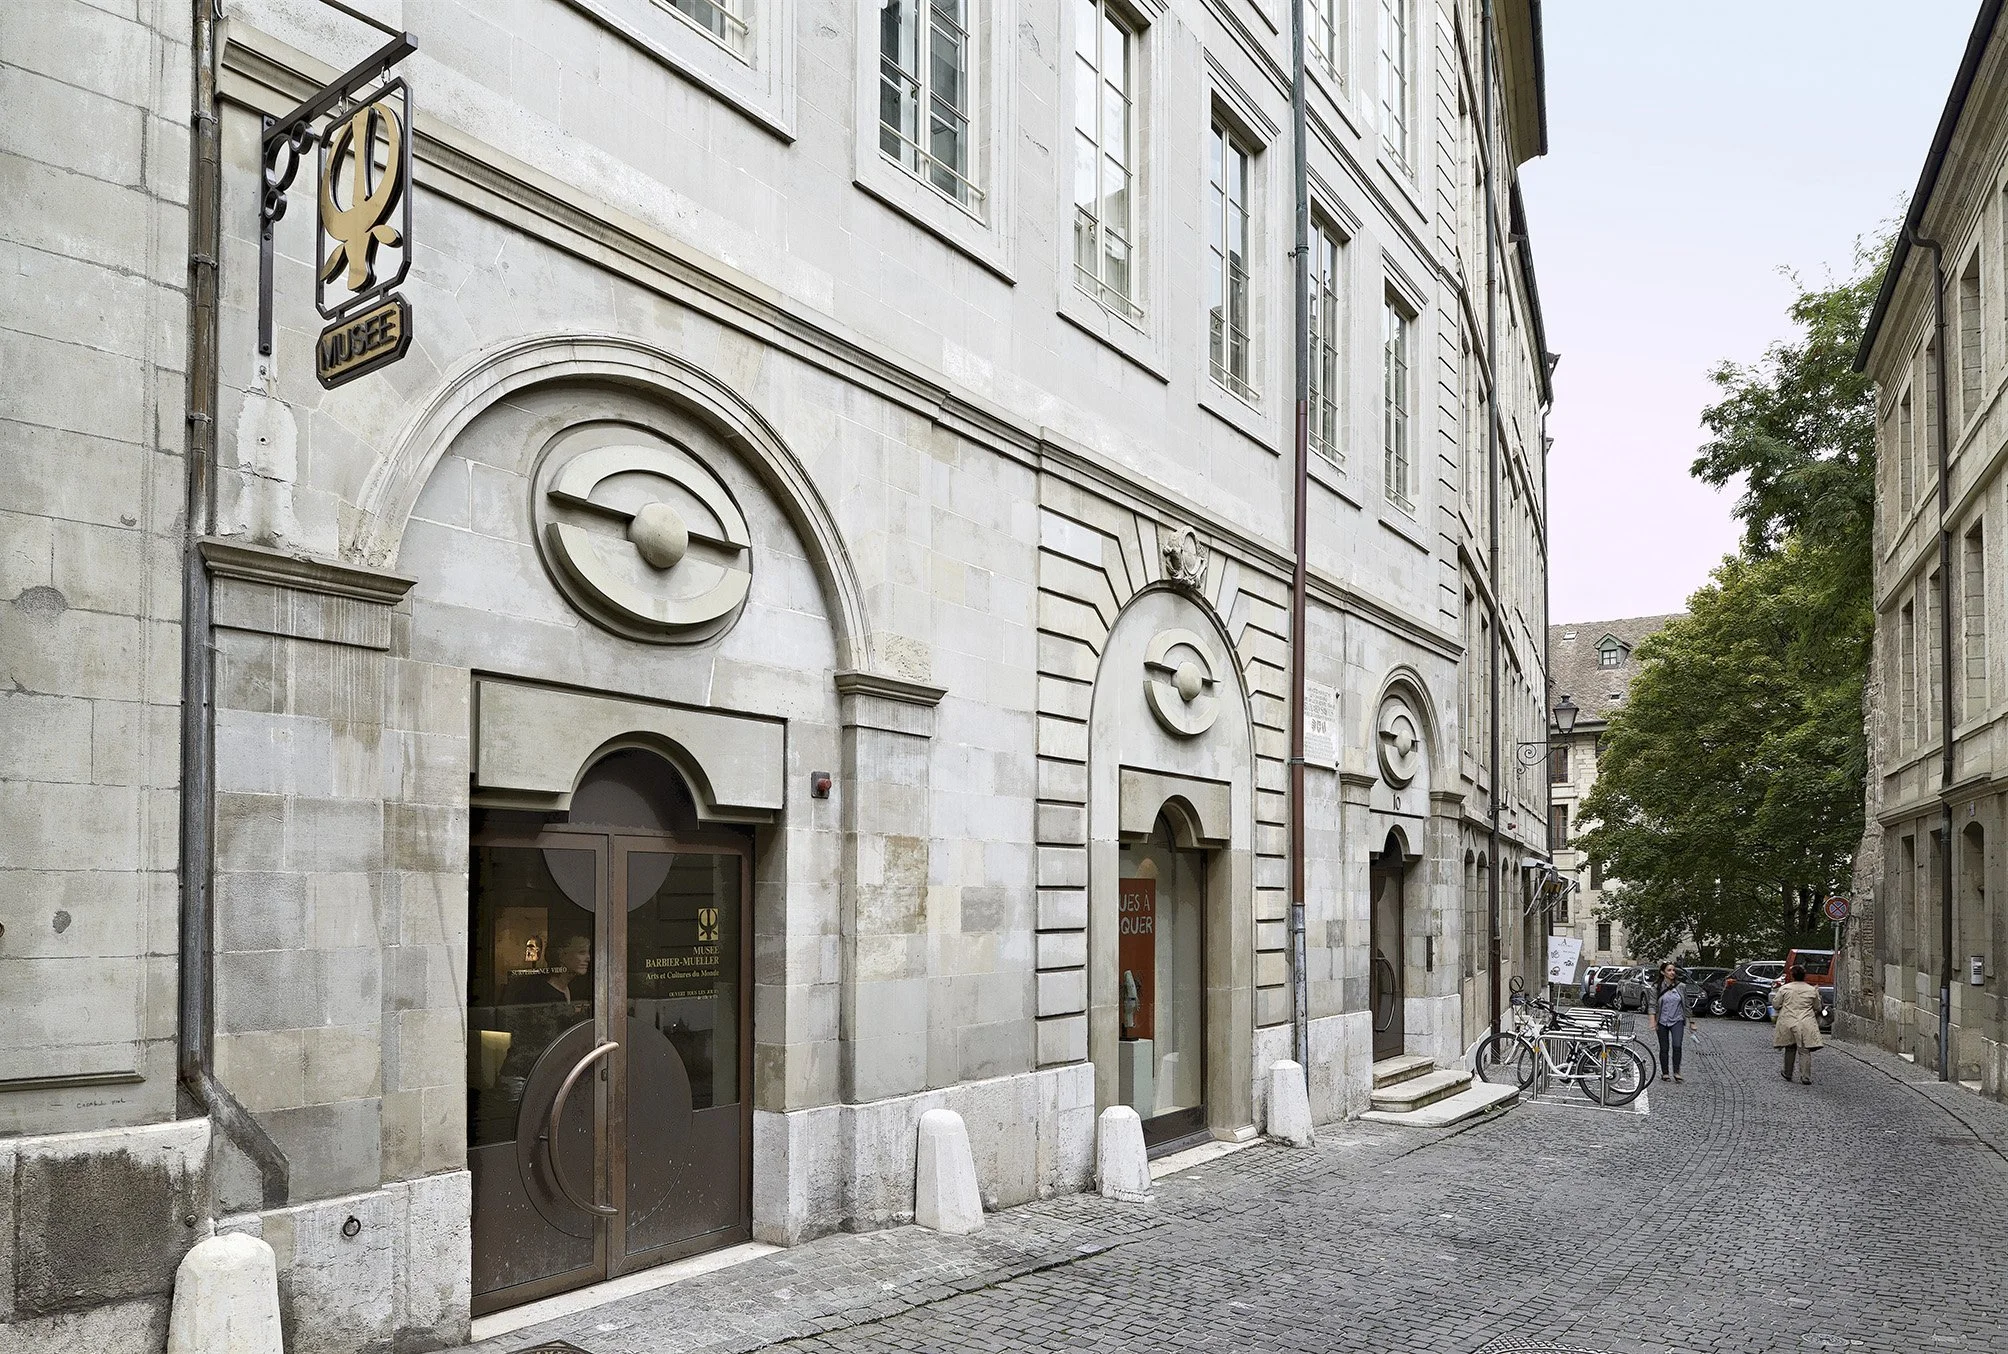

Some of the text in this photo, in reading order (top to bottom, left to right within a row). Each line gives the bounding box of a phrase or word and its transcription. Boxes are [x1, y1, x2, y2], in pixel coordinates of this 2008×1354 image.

[320, 309, 397, 371] MUSEE
[1393, 793, 1401, 810] 10
[1143, 889, 1150, 911] À
[693, 946, 719, 955] MUSEE
[645, 956, 719, 968] BARBIER-MUELLER
[667, 971, 691, 979] Cultures
